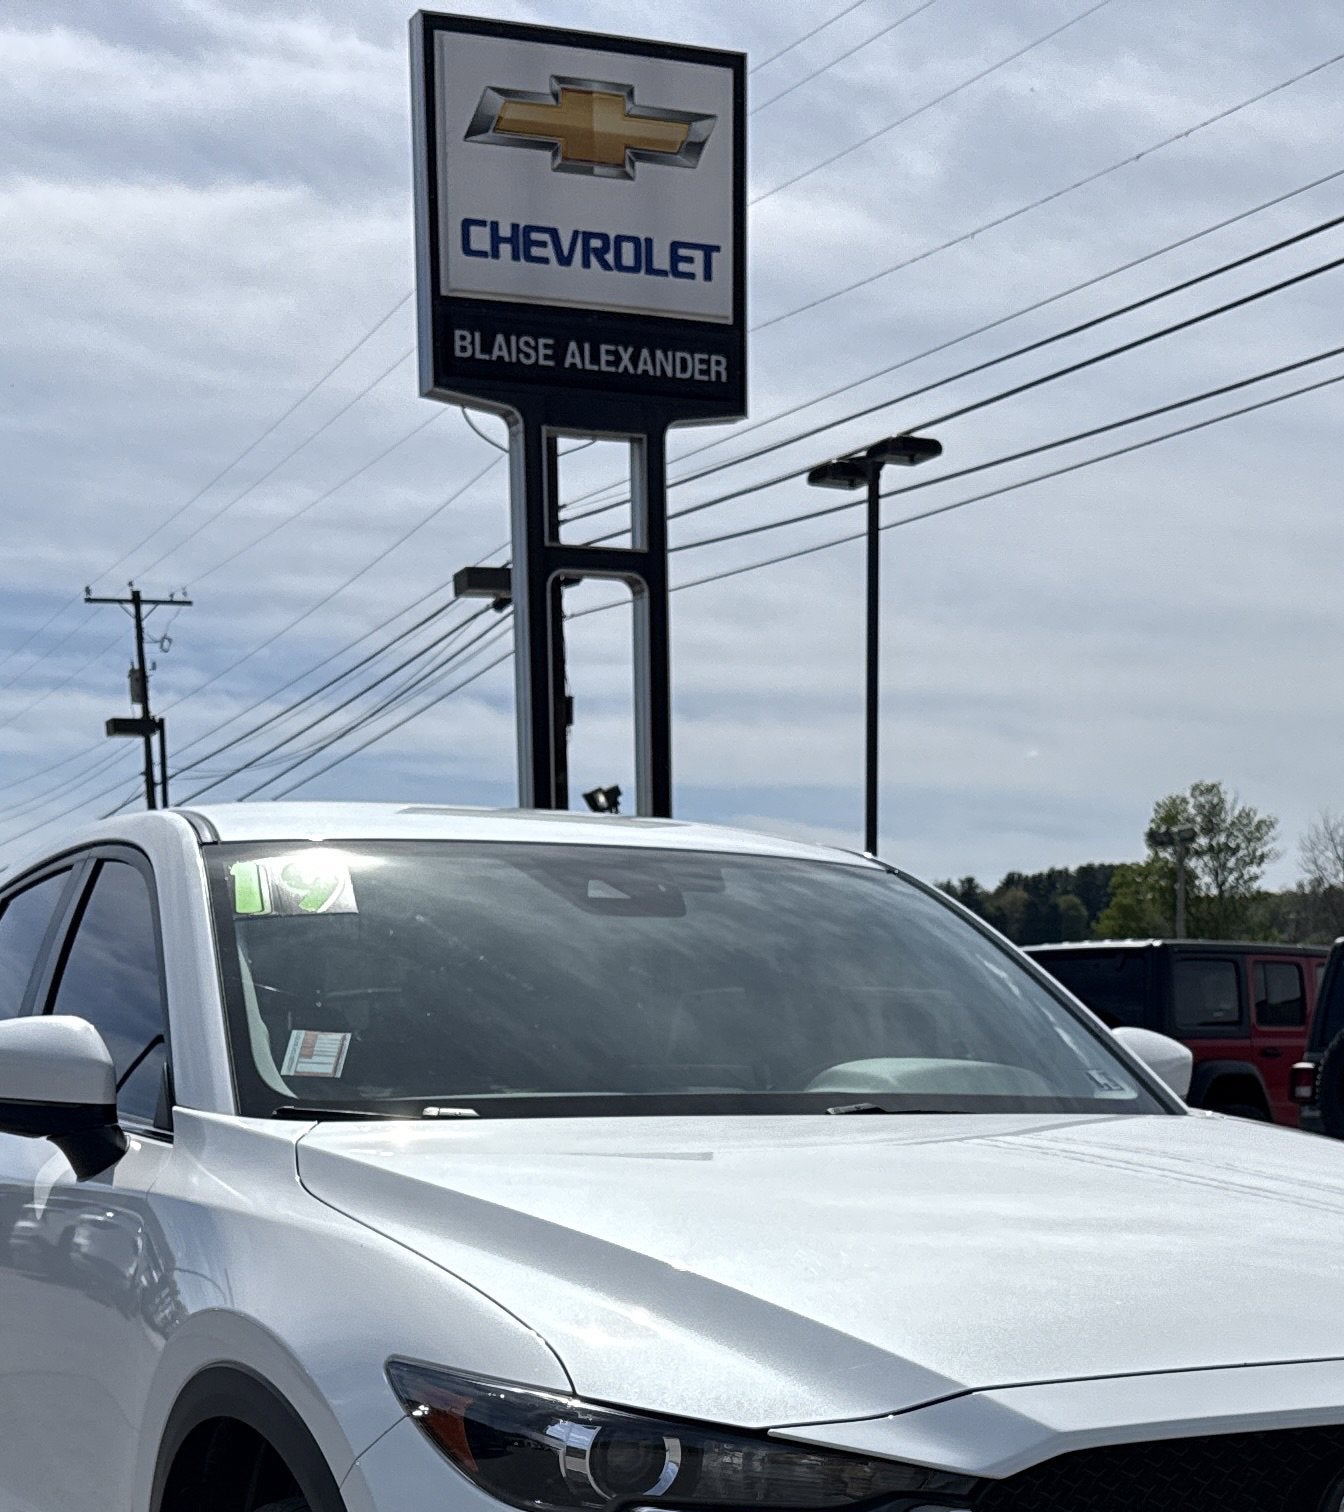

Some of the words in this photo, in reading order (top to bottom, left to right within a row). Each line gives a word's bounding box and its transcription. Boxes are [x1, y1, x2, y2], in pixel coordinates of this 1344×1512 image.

[461, 217, 721, 282] CHEVROLET
[454, 329, 555, 367] BLAISE
[563, 341, 728, 383] ALEXANDER
